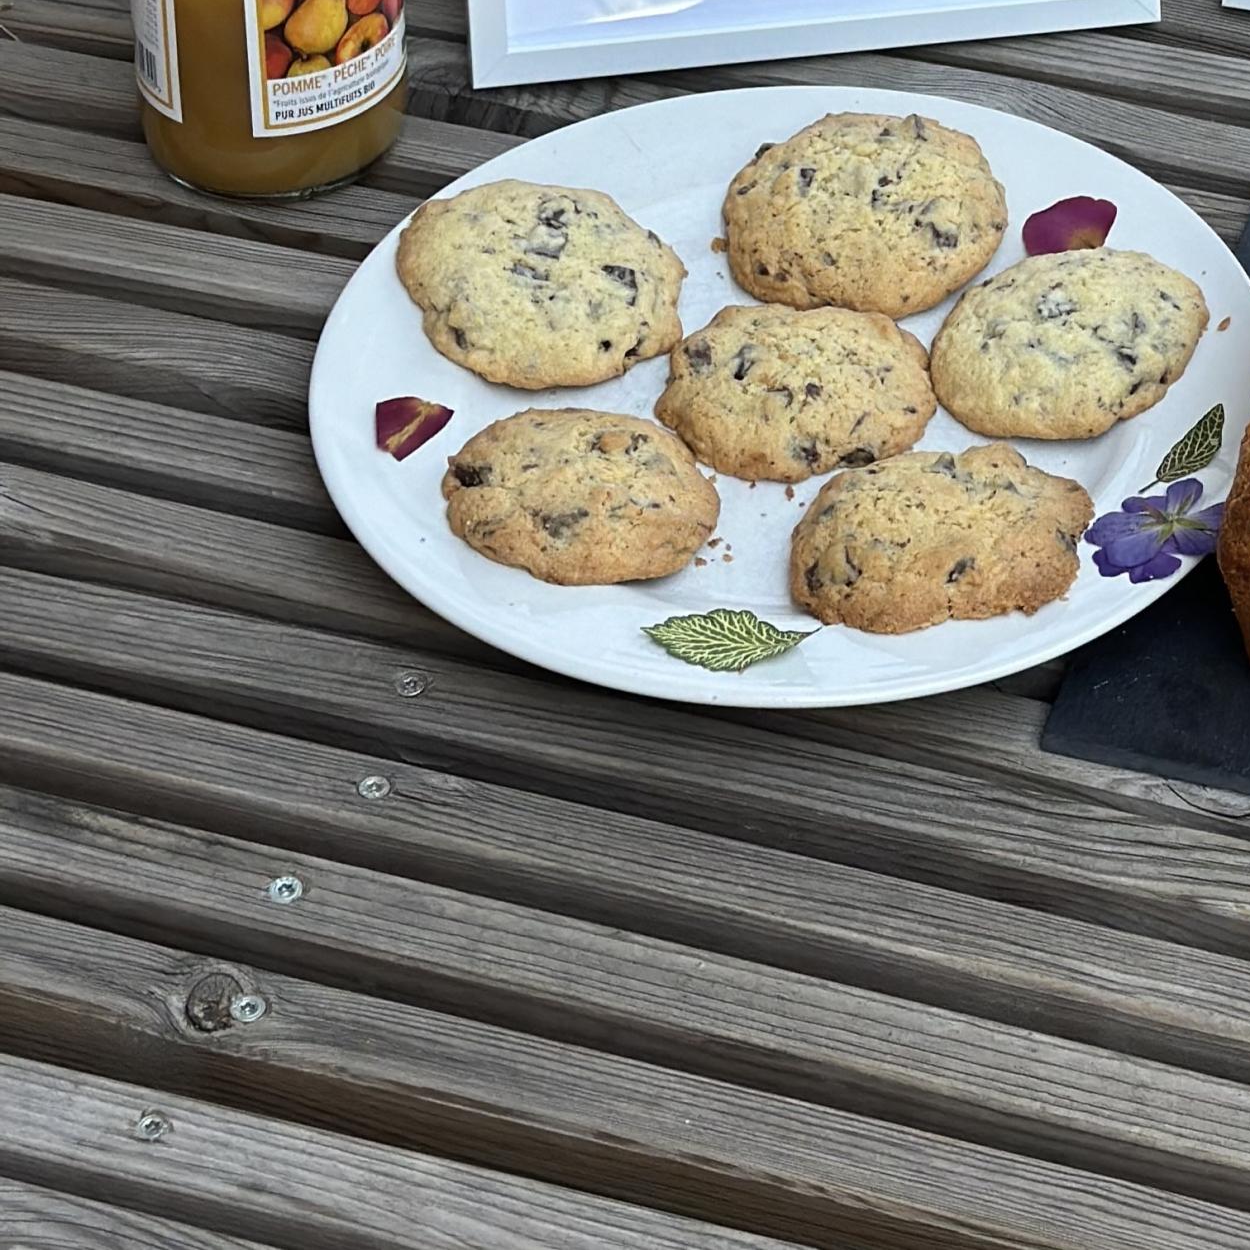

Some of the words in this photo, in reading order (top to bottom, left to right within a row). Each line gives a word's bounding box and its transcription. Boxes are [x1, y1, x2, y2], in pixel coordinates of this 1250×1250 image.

[275, 111, 295, 121] PUR
[297, 106, 314, 118] JUS
[363, 80, 376, 95] BIO
